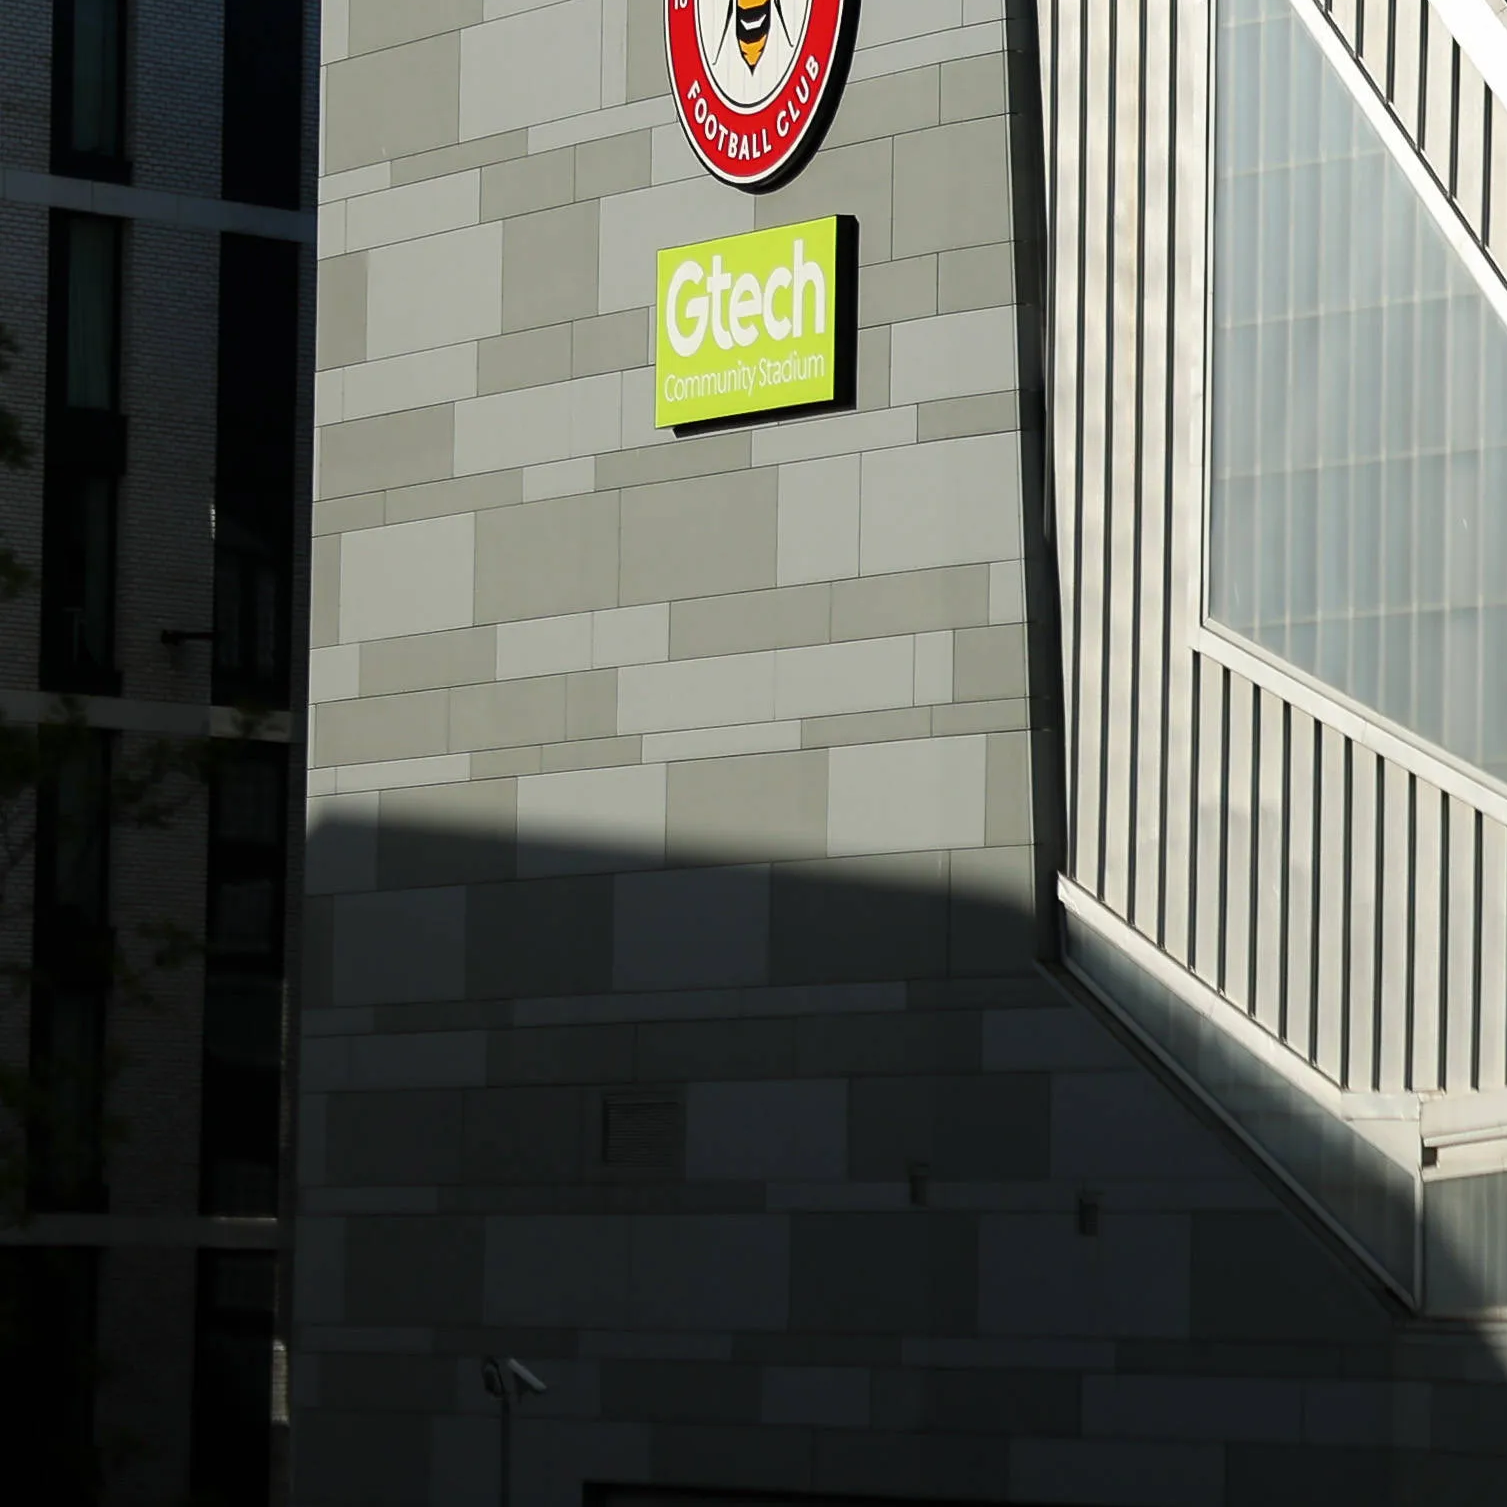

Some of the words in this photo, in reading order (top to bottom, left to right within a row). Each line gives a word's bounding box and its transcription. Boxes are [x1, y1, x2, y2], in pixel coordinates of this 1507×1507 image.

[688, 80, 772, 160] FOOTBALL
[777, 55, 819, 137] CLUB
[667, 239, 825, 357] Gtech
[664, 361, 757, 402] Community
[759, 351, 825, 386] Stadium
